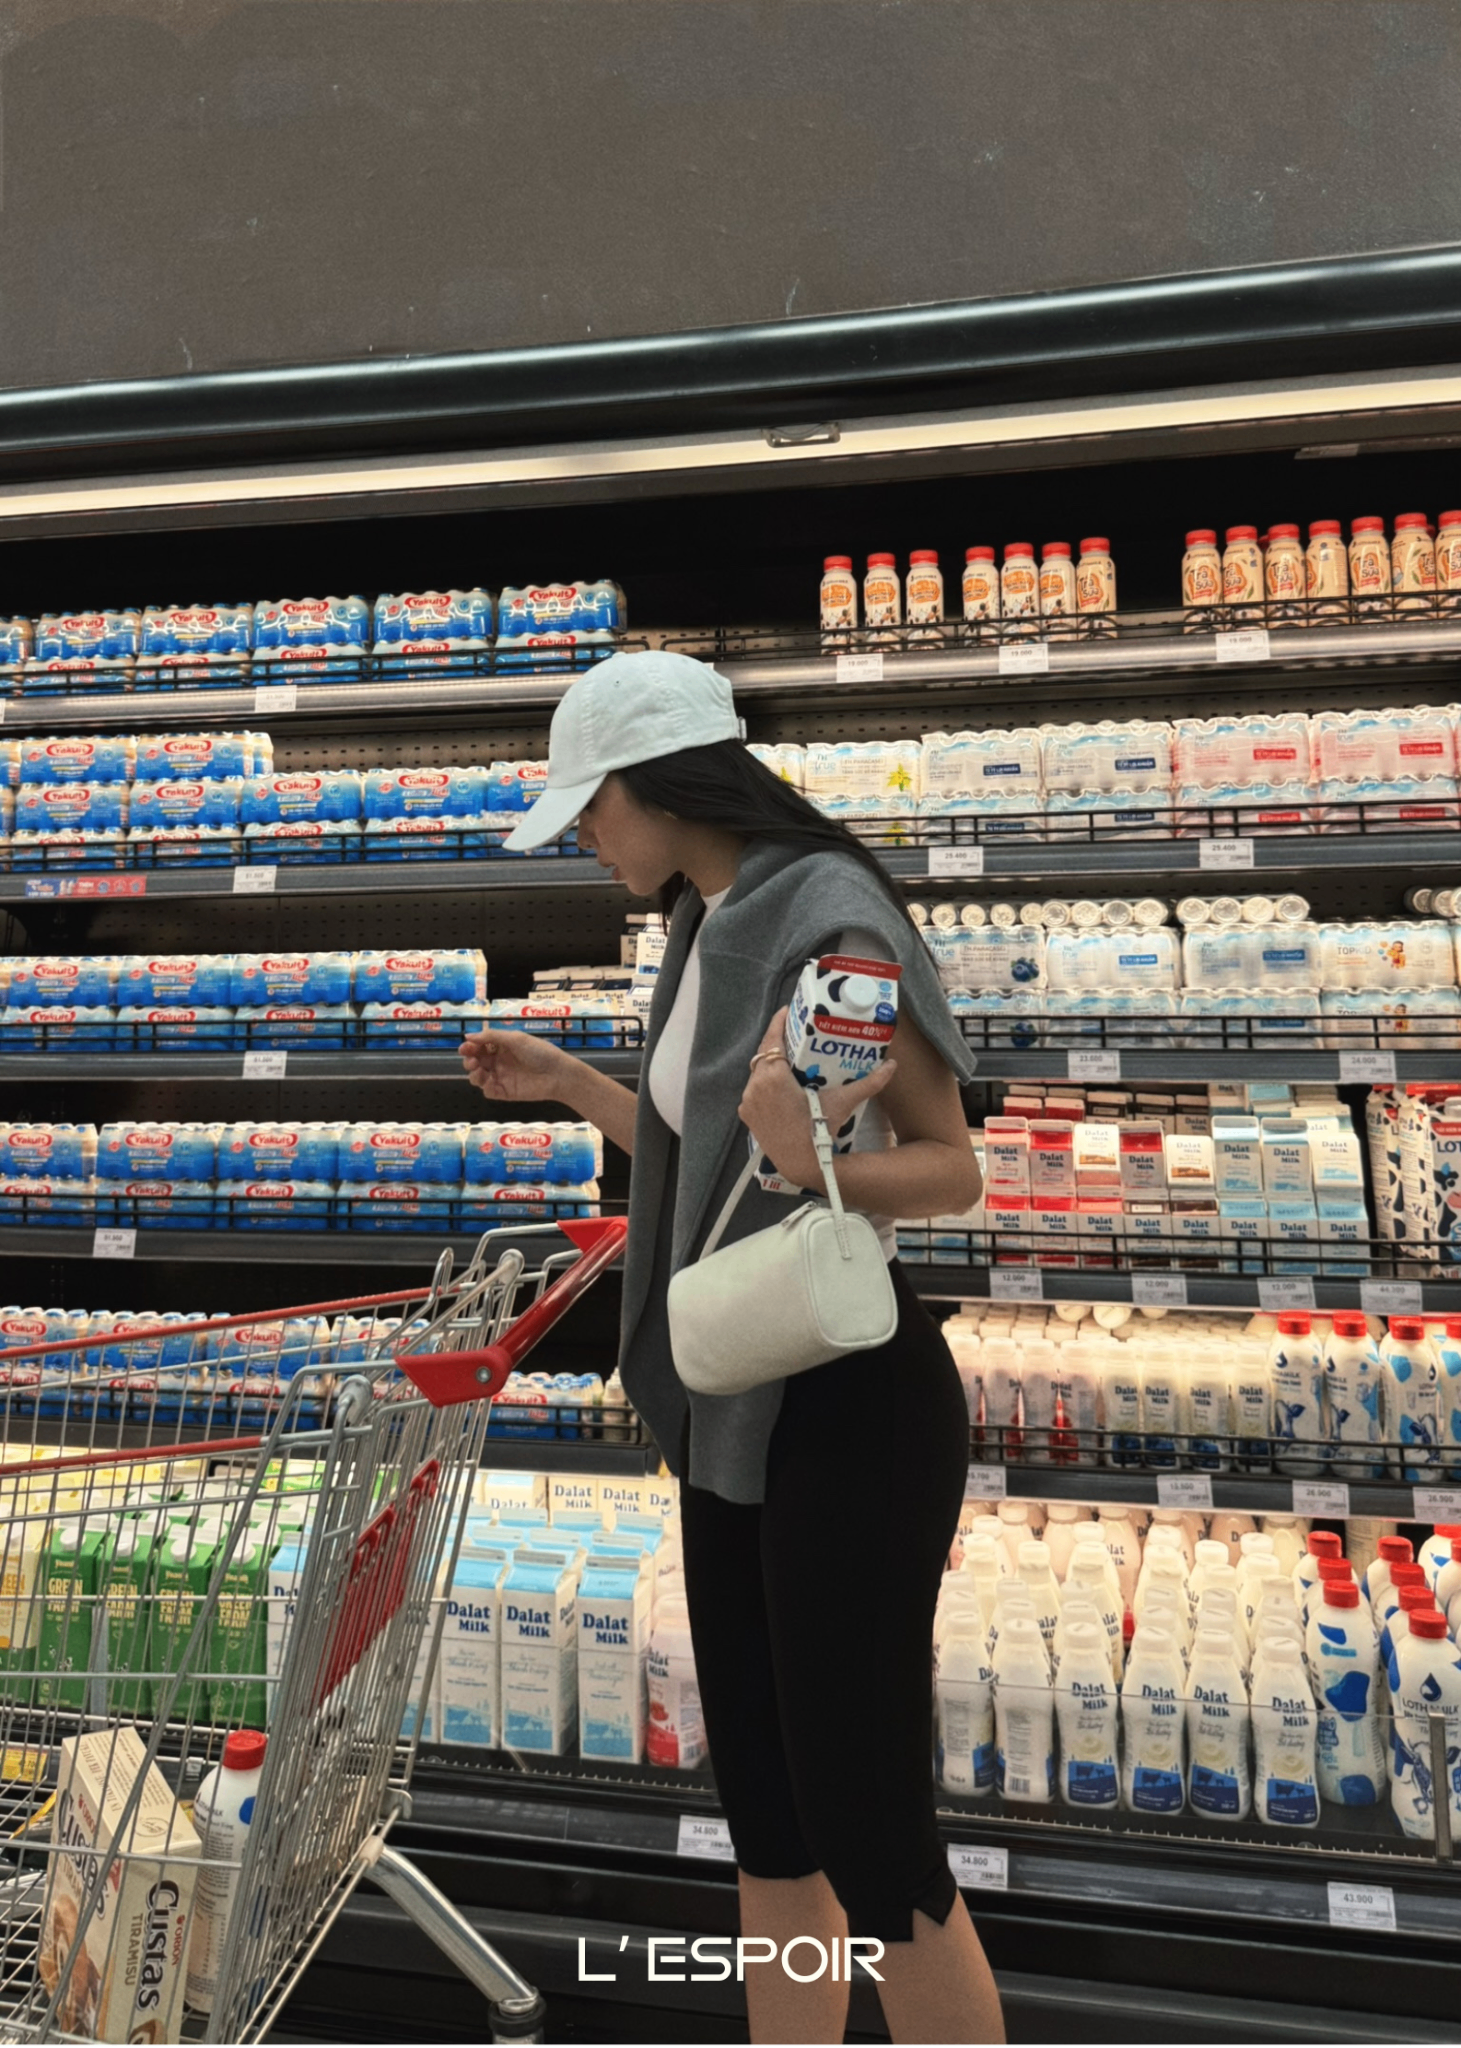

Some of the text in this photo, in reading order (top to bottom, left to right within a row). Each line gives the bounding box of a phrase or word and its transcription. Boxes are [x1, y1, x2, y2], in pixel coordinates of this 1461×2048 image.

[810, 1037, 877, 1061] LOTHA
[839, 1058, 876, 1071] MILK
[993, 1146, 1018, 1155] Dalat
[1224, 1144, 1250, 1153] Dalat
[1273, 1148, 1300, 1157] Dalat
[1039, 1153, 1064, 1161] Dalat
[1128, 1155, 1154, 1163] Dalat
[995, 1213, 1020, 1222] Dalat
[1042, 1214, 1067, 1223] Dalat
[1087, 1216, 1113, 1225] Dalat
[1135, 1218, 1161, 1227] Dalat
[1182, 1220, 1209, 1228] Dalat
[1231, 1221, 1258, 1230] Dalat
[1280, 1223, 1307, 1232] Dalat
[1330, 1223, 1357, 1232] Dalat
[1145, 1280, 1169, 1288] 12.000
[1145, 1386, 1169, 1396] Dalat
[1239, 1385, 1263, 1396] Dalat
[554, 1484, 593, 1497] Dalat
[603, 1487, 640, 1501] Dalat
[565, 1499, 592, 1509] Milk
[614, 1502, 640, 1513] Milk
[447, 1601, 491, 1619] Dalat
[507, 1605, 551, 1625] Dalat
[458, 1619, 491, 1633] Milk
[583, 1613, 629, 1631] Dalat
[519, 1624, 551, 1639] Milk
[595, 1631, 629, 1645] Milk
[1072, 1682, 1106, 1696] Dalat
[1142, 1684, 1176, 1700] Dalat
[1194, 1686, 1228, 1704] Dalat
[1082, 1700, 1108, 1710] Milk
[1151, 1704, 1177, 1715] Milk
[1202, 1704, 1230, 1717] Milk
[1272, 1697, 1306, 1713] Dalat
[1282, 1715, 1309, 1727] Milk
[960, 1855, 989, 1867] 34.800
[1343, 1893, 1373, 1905] 43.900
[125, 1913, 144, 1987] TIRAMISU
[136, 1879, 180, 2012] Custas
[172, 1926, 184, 1967] ORION
